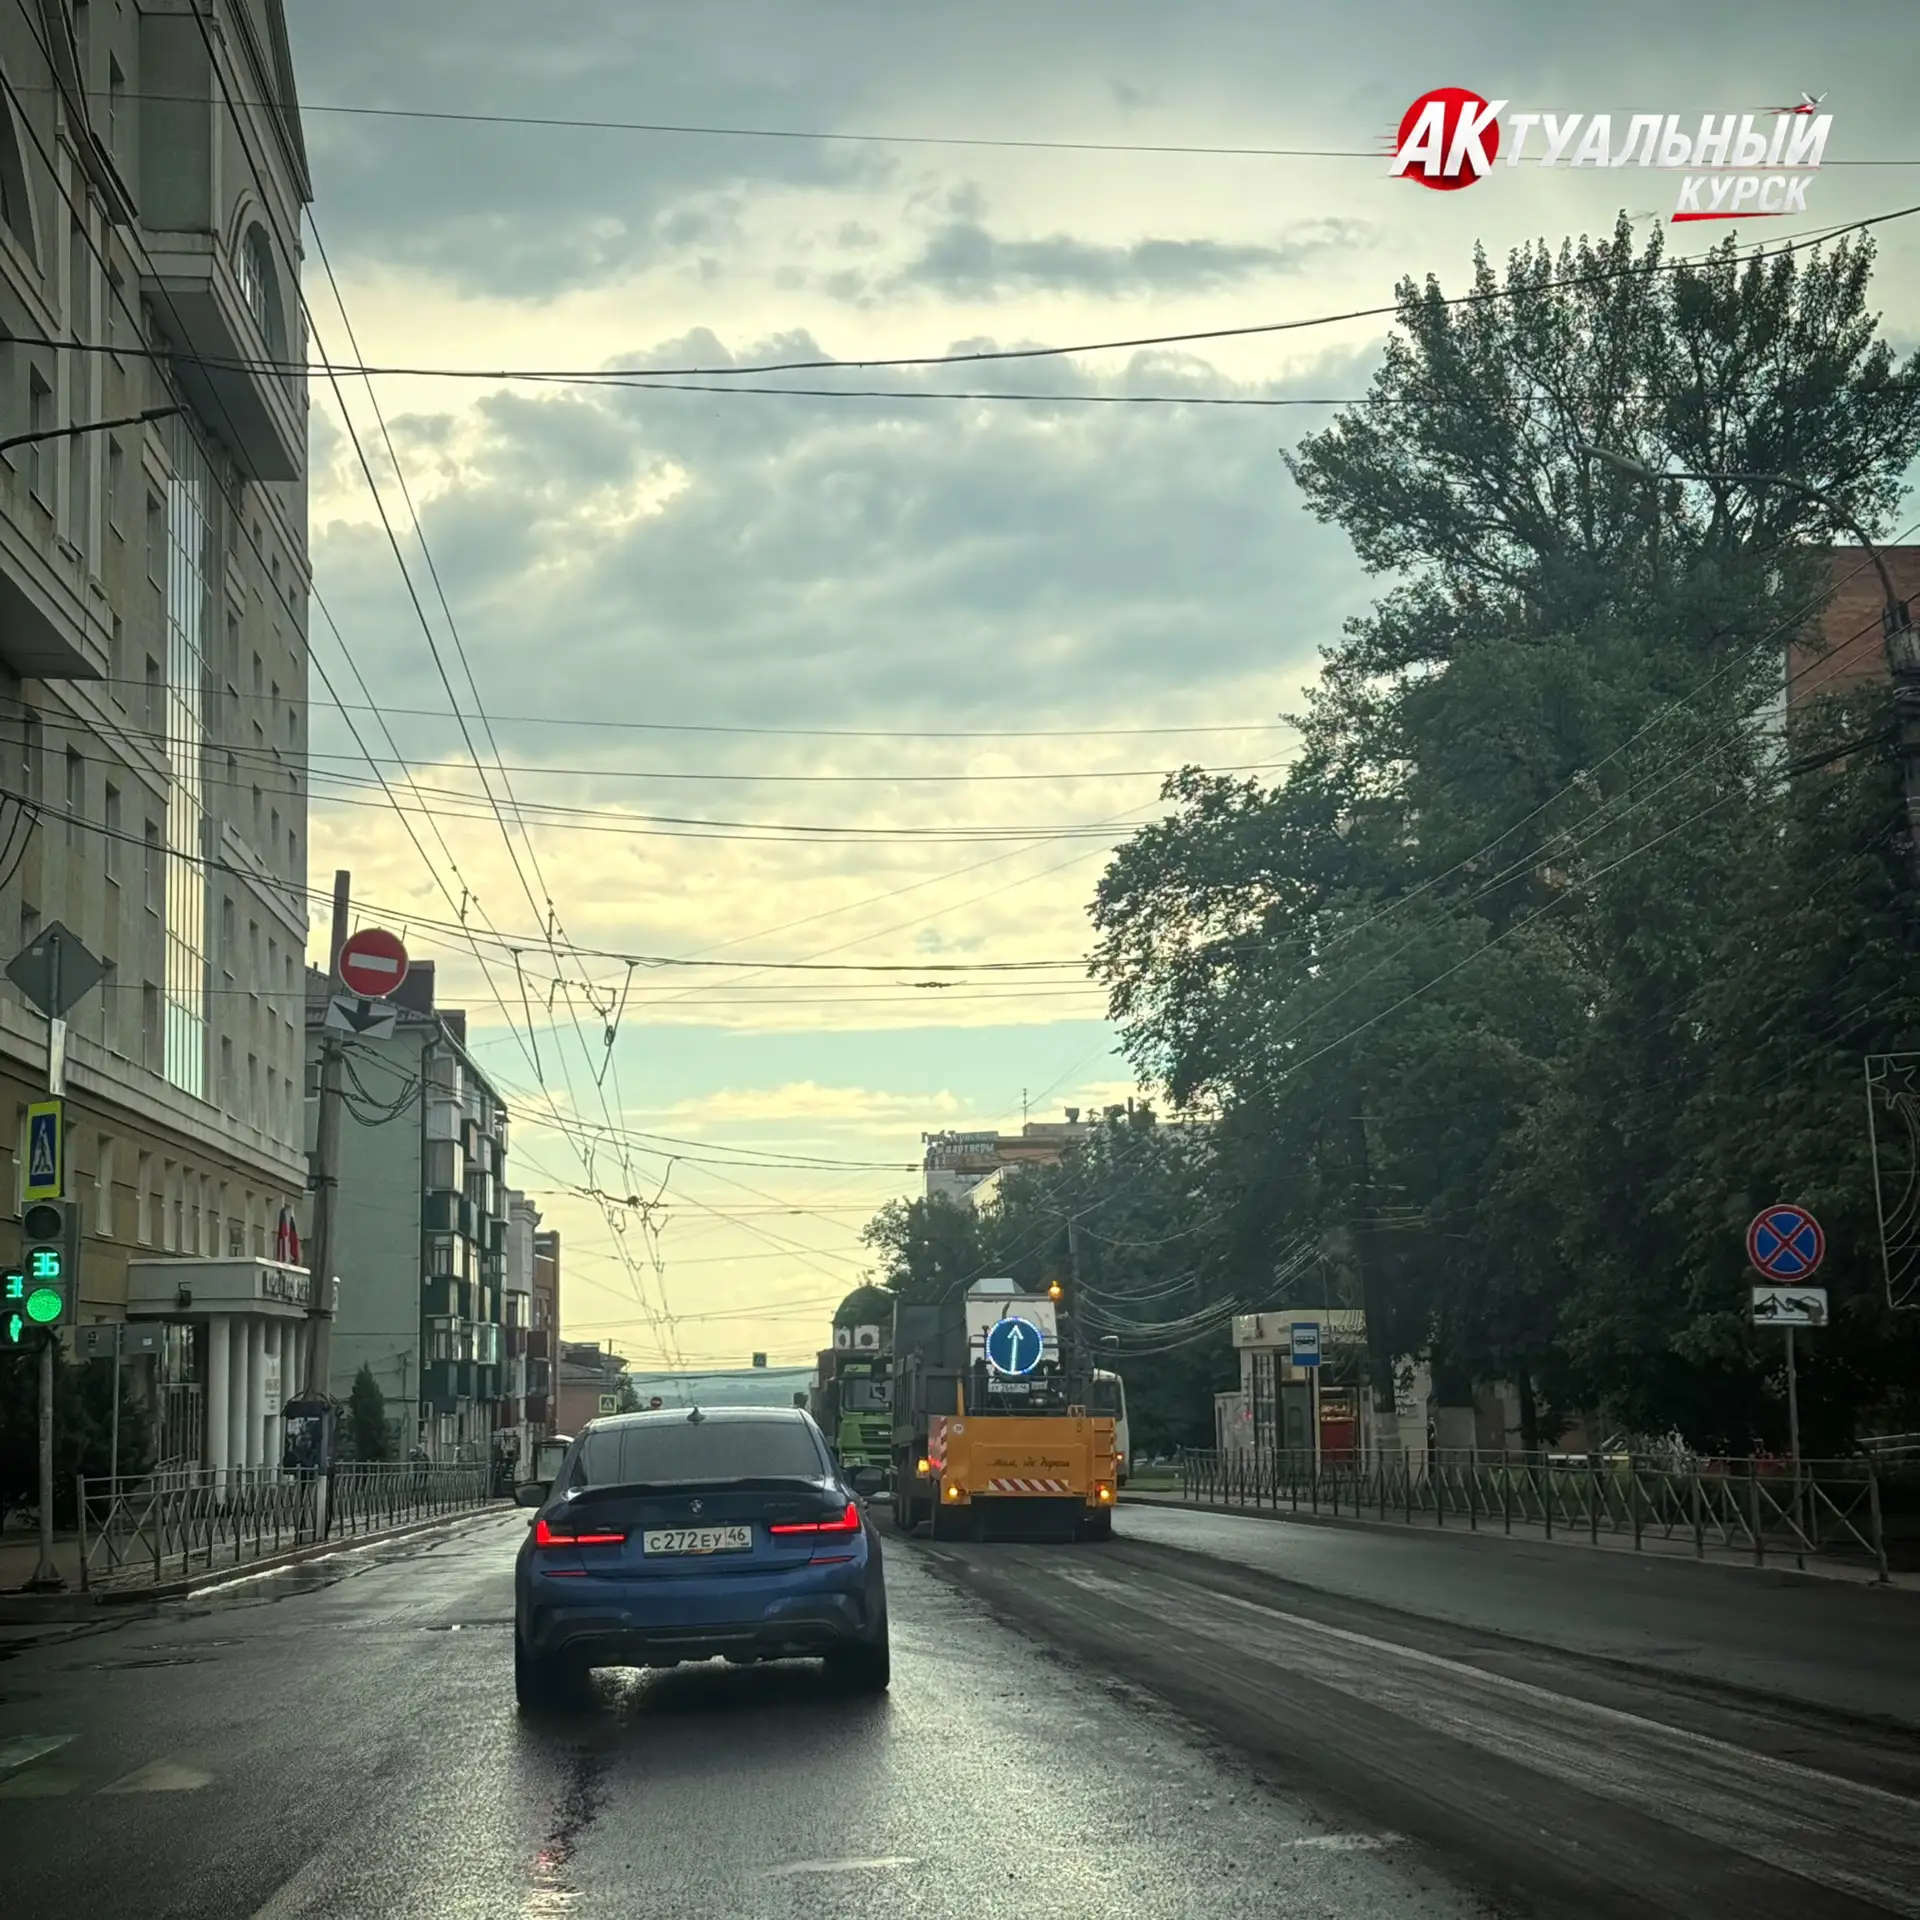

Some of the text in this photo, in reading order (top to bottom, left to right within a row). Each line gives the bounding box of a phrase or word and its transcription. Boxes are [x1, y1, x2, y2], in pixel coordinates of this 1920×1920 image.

[33, 1252, 60, 1277] 36
[650, 1528, 746, 1551] С272ЕУ 46
